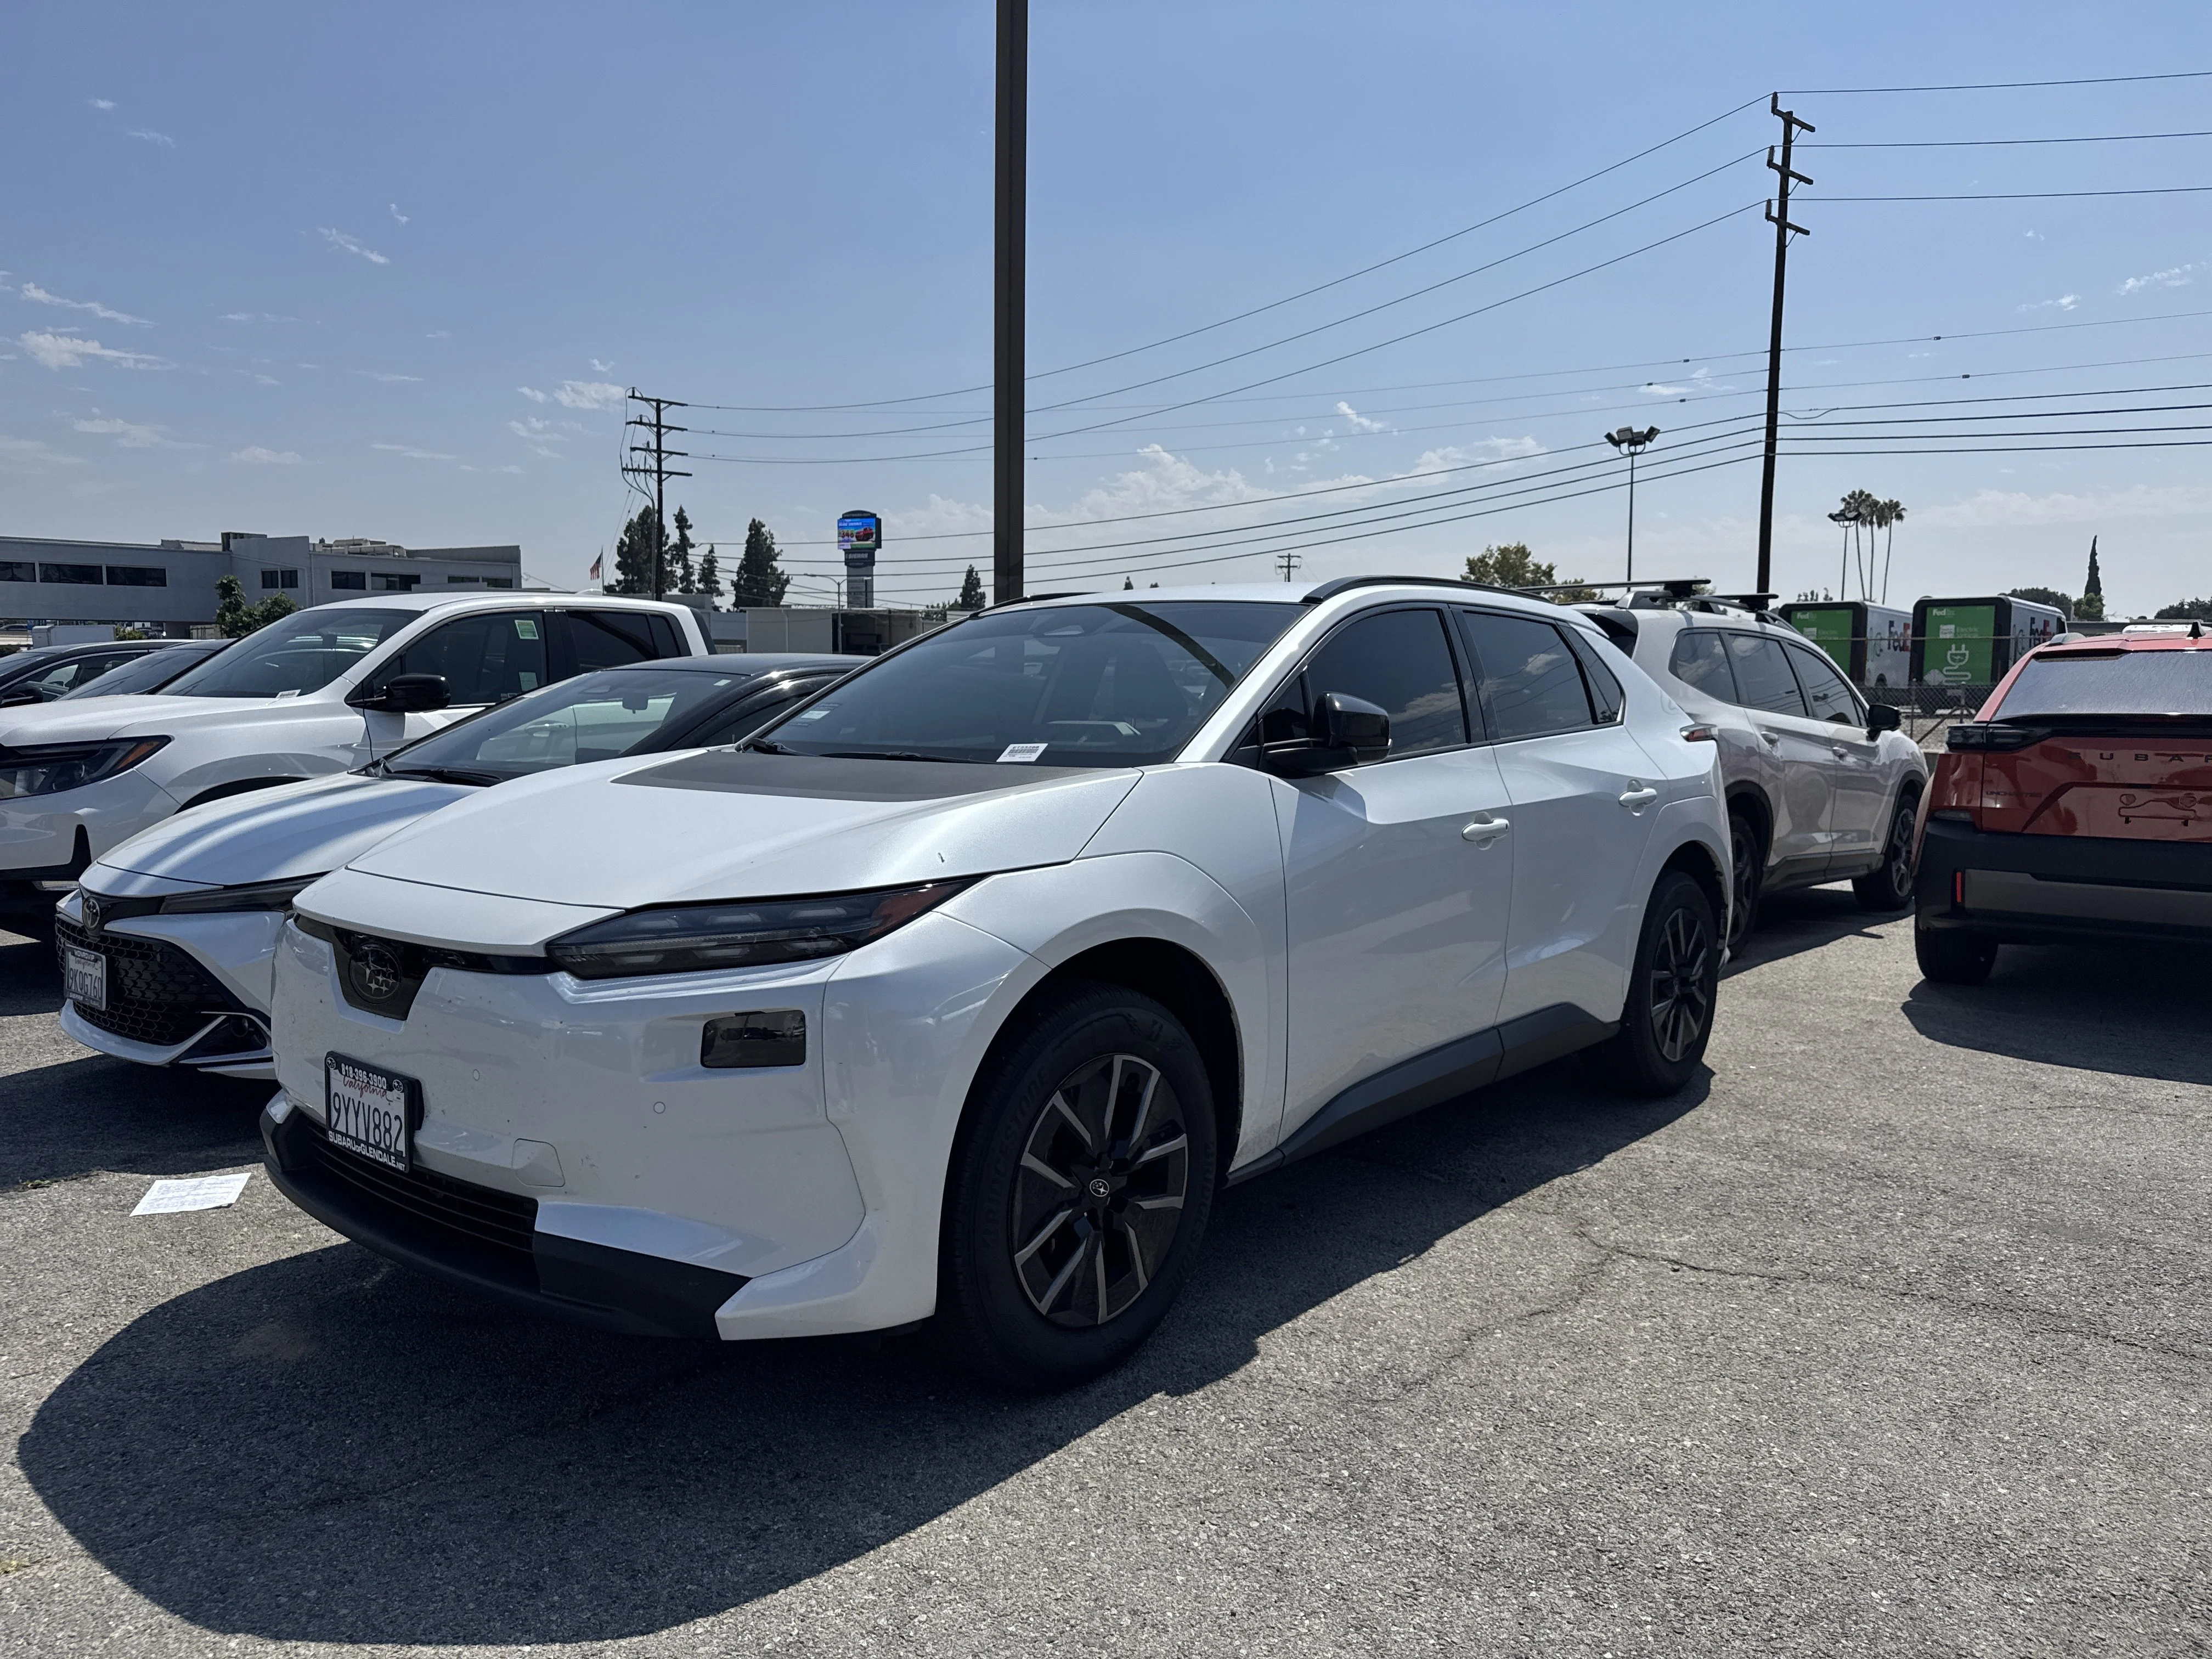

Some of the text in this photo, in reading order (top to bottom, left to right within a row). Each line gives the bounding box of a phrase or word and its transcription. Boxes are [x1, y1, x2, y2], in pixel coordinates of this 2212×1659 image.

[1888, 620, 1911, 652] FedE
[341, 1063, 387, 1090] 818-396-3900
[332, 1092, 405, 1156] 9YYV882
[328, 1130, 356, 1151] SUBARU
